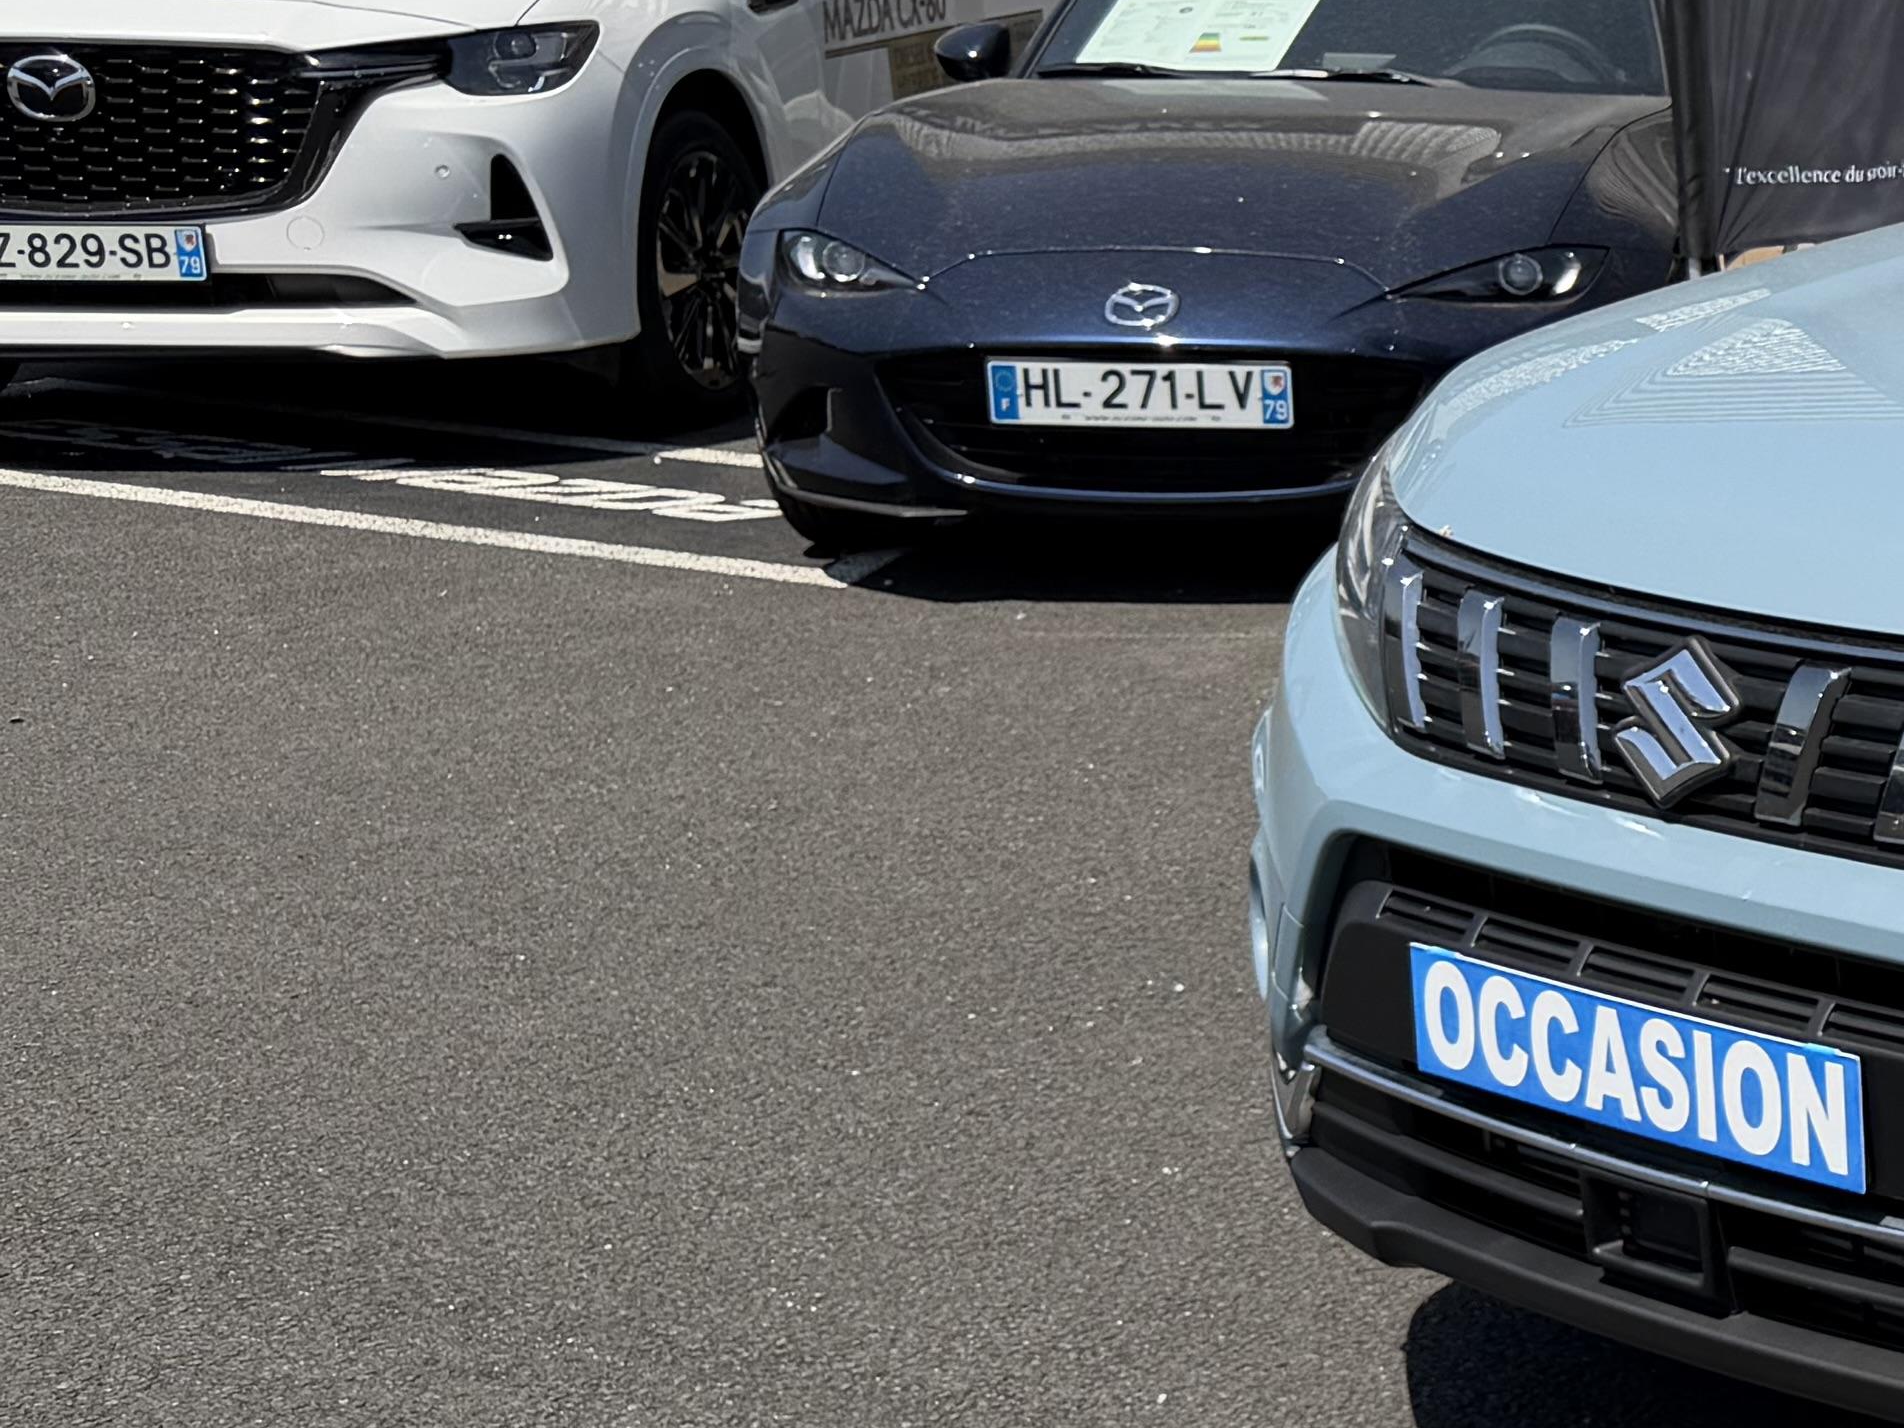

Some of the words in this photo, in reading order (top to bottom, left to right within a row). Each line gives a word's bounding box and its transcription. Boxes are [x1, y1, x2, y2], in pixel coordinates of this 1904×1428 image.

[1845, 165, 1864, 182] du
[180, 255, 201, 273] 79
[1022, 368, 1254, 410] HL-271-LV
[1263, 400, 1288, 421] 79
[1423, 959, 1850, 1176] OCCASION
